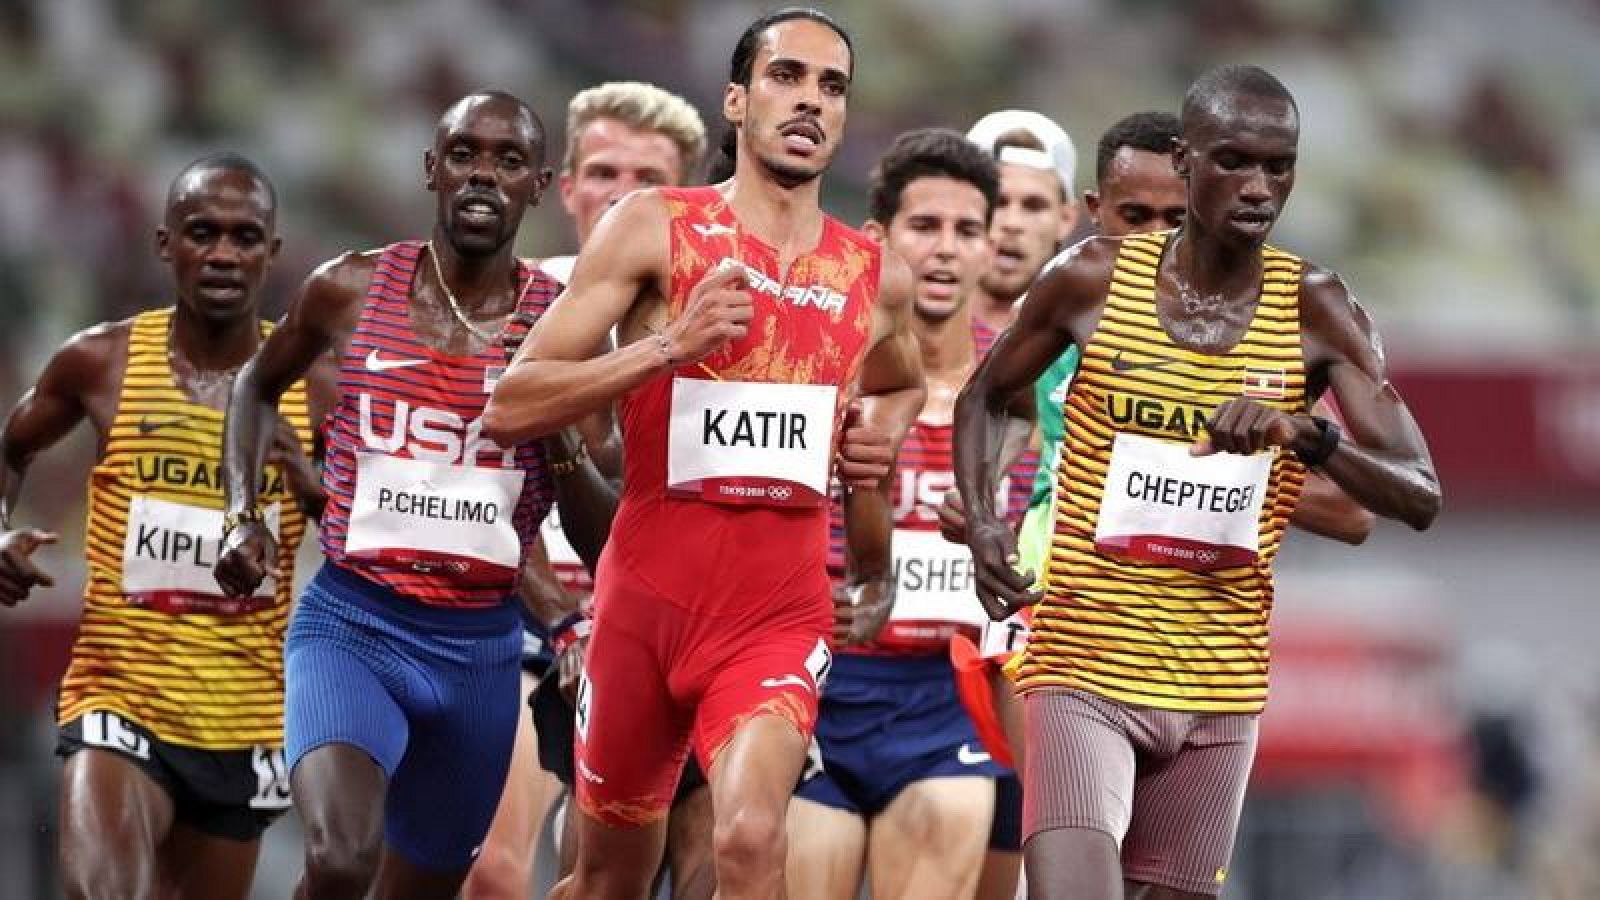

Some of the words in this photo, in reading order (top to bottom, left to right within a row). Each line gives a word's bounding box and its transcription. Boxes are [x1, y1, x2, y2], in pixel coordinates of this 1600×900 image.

[703, 408, 807, 450] KATIR
[1108, 393, 1210, 437] UGAN
[136, 455, 286, 495] UGAA
[1126, 471, 1256, 513] CHEPTEGEI
[378, 487, 499, 525] P.CHELIMO
[136, 523, 223, 569] KIPL
[895, 557, 976, 593] ISHE
